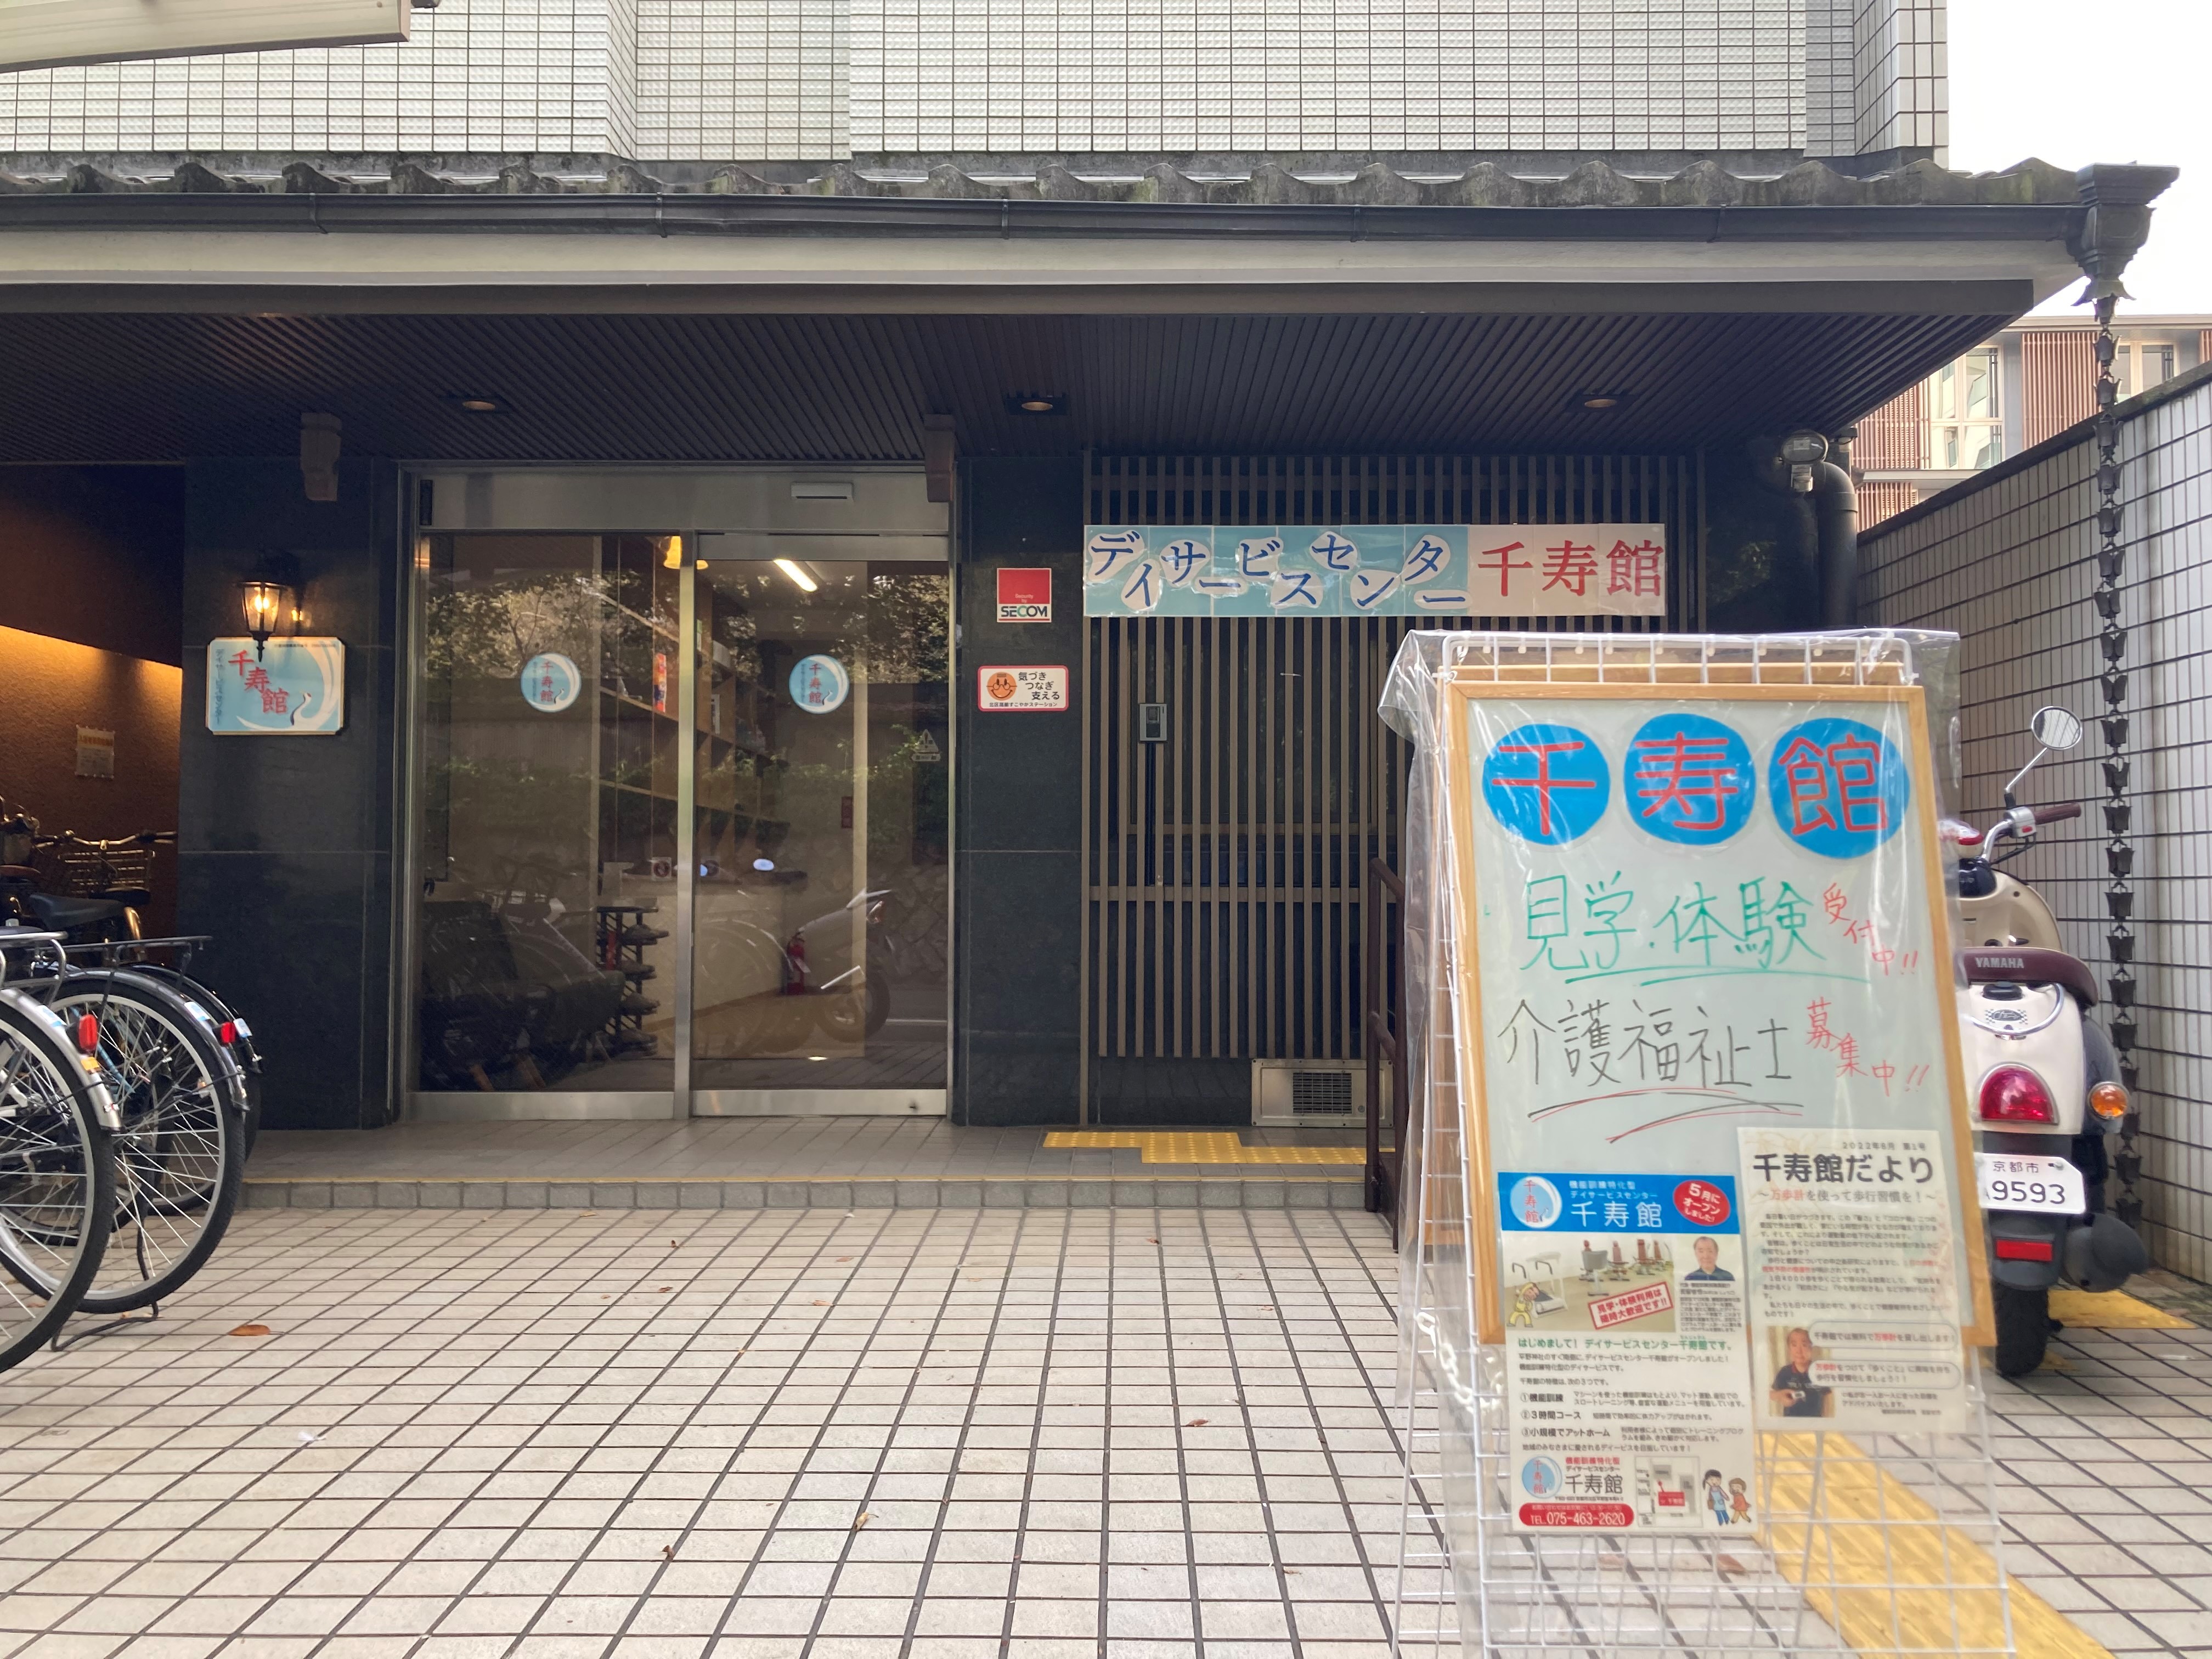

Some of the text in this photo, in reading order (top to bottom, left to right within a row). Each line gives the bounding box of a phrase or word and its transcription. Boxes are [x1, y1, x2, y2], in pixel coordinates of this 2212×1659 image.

[1477, 540, 1664, 597] 千寿館
[1001, 605, 1047, 617] SECOM
[228, 650, 290, 715] 千寿館
[809, 663, 822, 703] 千寿館
[1018, 672, 1046, 681] 気づき
[1025, 681, 1054, 690] つなぎ
[1031, 691, 1060, 700] 支える
[1492, 731, 1888, 836] 千寿館
[1975, 957, 2024, 968] YAMAHA
[1497, 998, 1793, 1088] 介護福祉士
[1753, 1153, 1933, 1183] 千寿館だより
[1993, 1161, 2039, 1173] 京都市
[1689, 1183, 1720, 1204] 5月に
[1992, 1181, 2065, 1204] 9593
[1571, 1201, 1662, 1228] 千寿館
[1683, 1198, 1720, 1215] オープン
[1565, 1474, 1623, 1494] 千寿館
